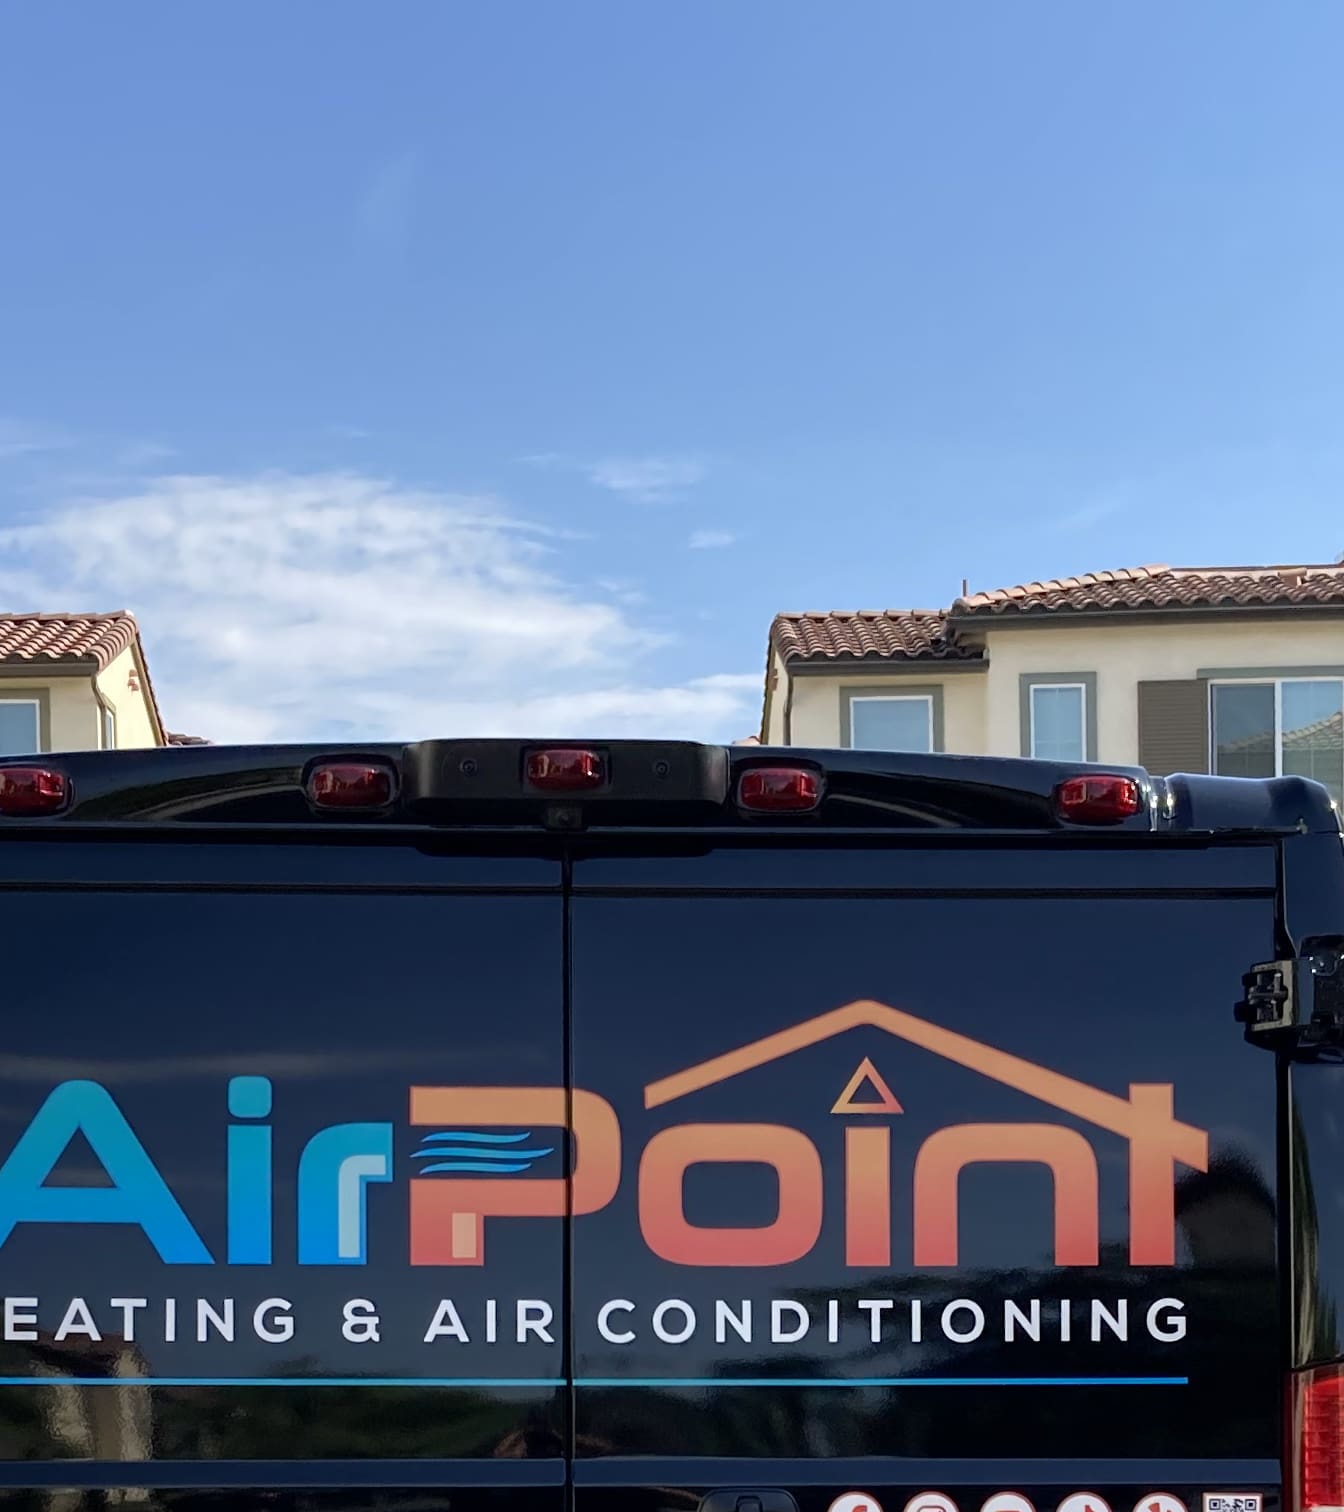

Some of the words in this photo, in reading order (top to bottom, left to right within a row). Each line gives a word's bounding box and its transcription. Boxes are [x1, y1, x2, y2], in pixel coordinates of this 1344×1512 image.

[342, 1298, 380, 1343] &
[424, 1297, 554, 1343] AIR
[597, 1297, 1187, 1343] CONDITIONING
